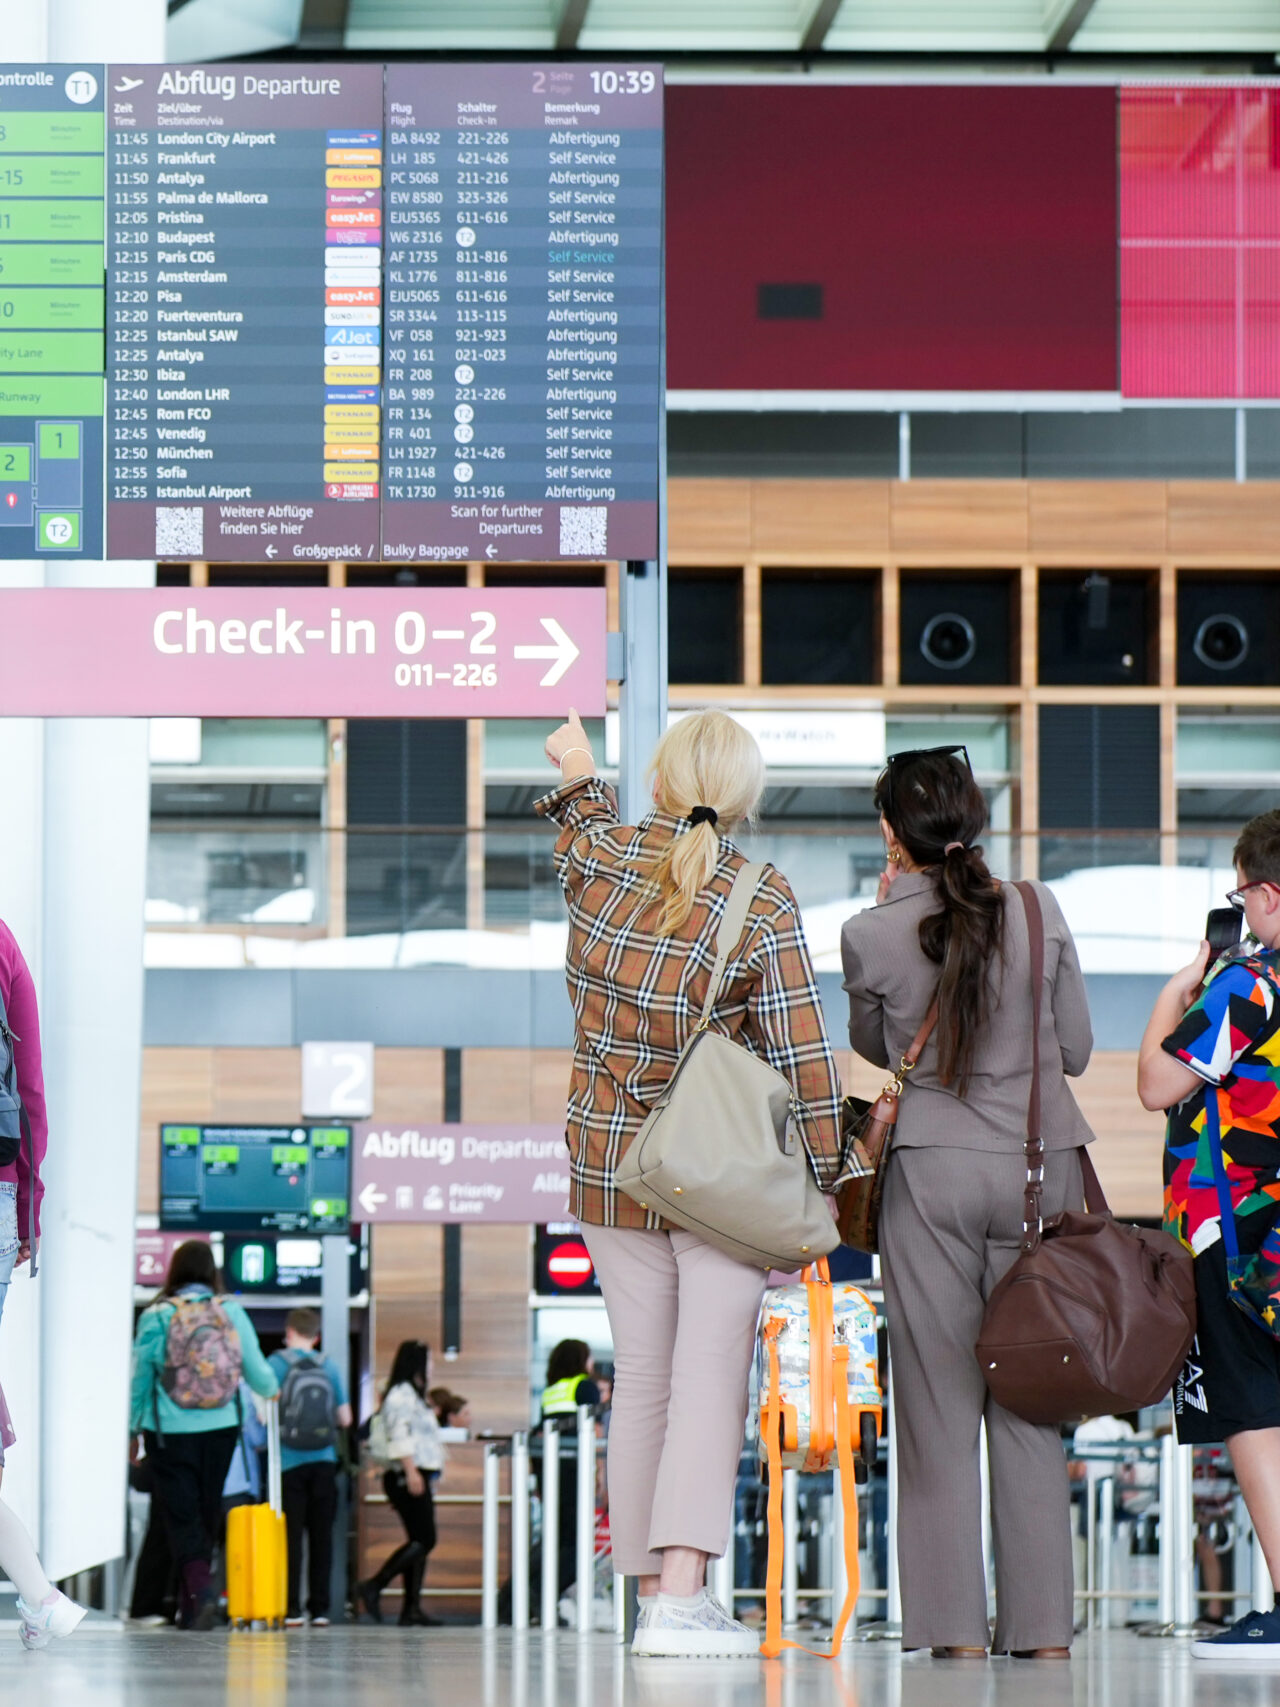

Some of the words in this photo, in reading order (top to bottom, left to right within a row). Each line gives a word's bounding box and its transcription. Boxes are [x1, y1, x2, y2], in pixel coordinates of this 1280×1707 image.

[72, 80, 89, 95] T1
[157, 70, 235, 100] Abflug
[244, 76, 340, 99] Departure
[532, 72, 545, 93] 2
[590, 71, 655, 94] 10:39
[114, 103, 133, 113] Zeit
[158, 103, 202, 114] Ziel/über
[391, 103, 412, 115] Flug
[458, 102, 497, 112] Schalter
[545, 102, 600, 115] Bemerkung
[545, 116, 578, 125] Remark
[158, 132, 203, 144] London
[206, 132, 230, 147] City
[232, 132, 275, 147] Airport
[158, 152, 216, 164] Frankfurt
[157, 171, 204, 187] Antalya
[158, 191, 195, 204] Palma
[198, 191, 213, 203] de
[216, 191, 268, 204] Mallorca
[158, 211, 203, 223] Pristina
[331, 212, 374, 226] easyJet
[391, 211, 440, 224] EJU5365
[158, 231, 215, 246] Budapest
[157, 250, 187, 263] Paris
[190, 251, 215, 263] CDG
[157, 270, 227, 282] Amsterdam
[157, 290, 182, 302] Pisa
[157, 310, 243, 322] Fuerteventura
[157, 329, 207, 341] Istanbul
[209, 330, 238, 342] SAW
[456, 329, 506, 341] 921-923
[18, 349, 43, 358] Lane
[157, 368, 185, 381] Ibiza
[157, 408, 184, 420] Rom
[188, 408, 211, 420] FCO
[56, 433, 61, 448] 1
[156, 427, 206, 442] Venedig
[157, 446, 213, 459] München
[5, 454, 14, 471] 2
[115, 467, 147, 479] 12:55
[157, 466, 187, 479] Sofia
[220, 505, 265, 517] Weitere
[267, 505, 313, 520] Abflüge
[451, 505, 478, 517] Scan
[481, 504, 498, 517] for
[501, 505, 543, 517] further
[50, 521, 69, 536] T2
[220, 522, 257, 534] finden
[261, 522, 277, 534] Sie
[281, 522, 303, 534] hier
[479, 522, 543, 536] Departures
[293, 544, 361, 559] Großgepäck
[384, 544, 416, 559] Bulky
[419, 544, 469, 559] Baggage
[154, 608, 375, 654] Check-in
[331, 1054, 365, 1110] 2
[363, 1131, 455, 1165] Abflug
[462, 1137, 566, 1162] Departure
[449, 1183, 503, 1202] Priority
[450, 1200, 483, 1213] Lane
[1184, 1333, 1208, 1413] A7
